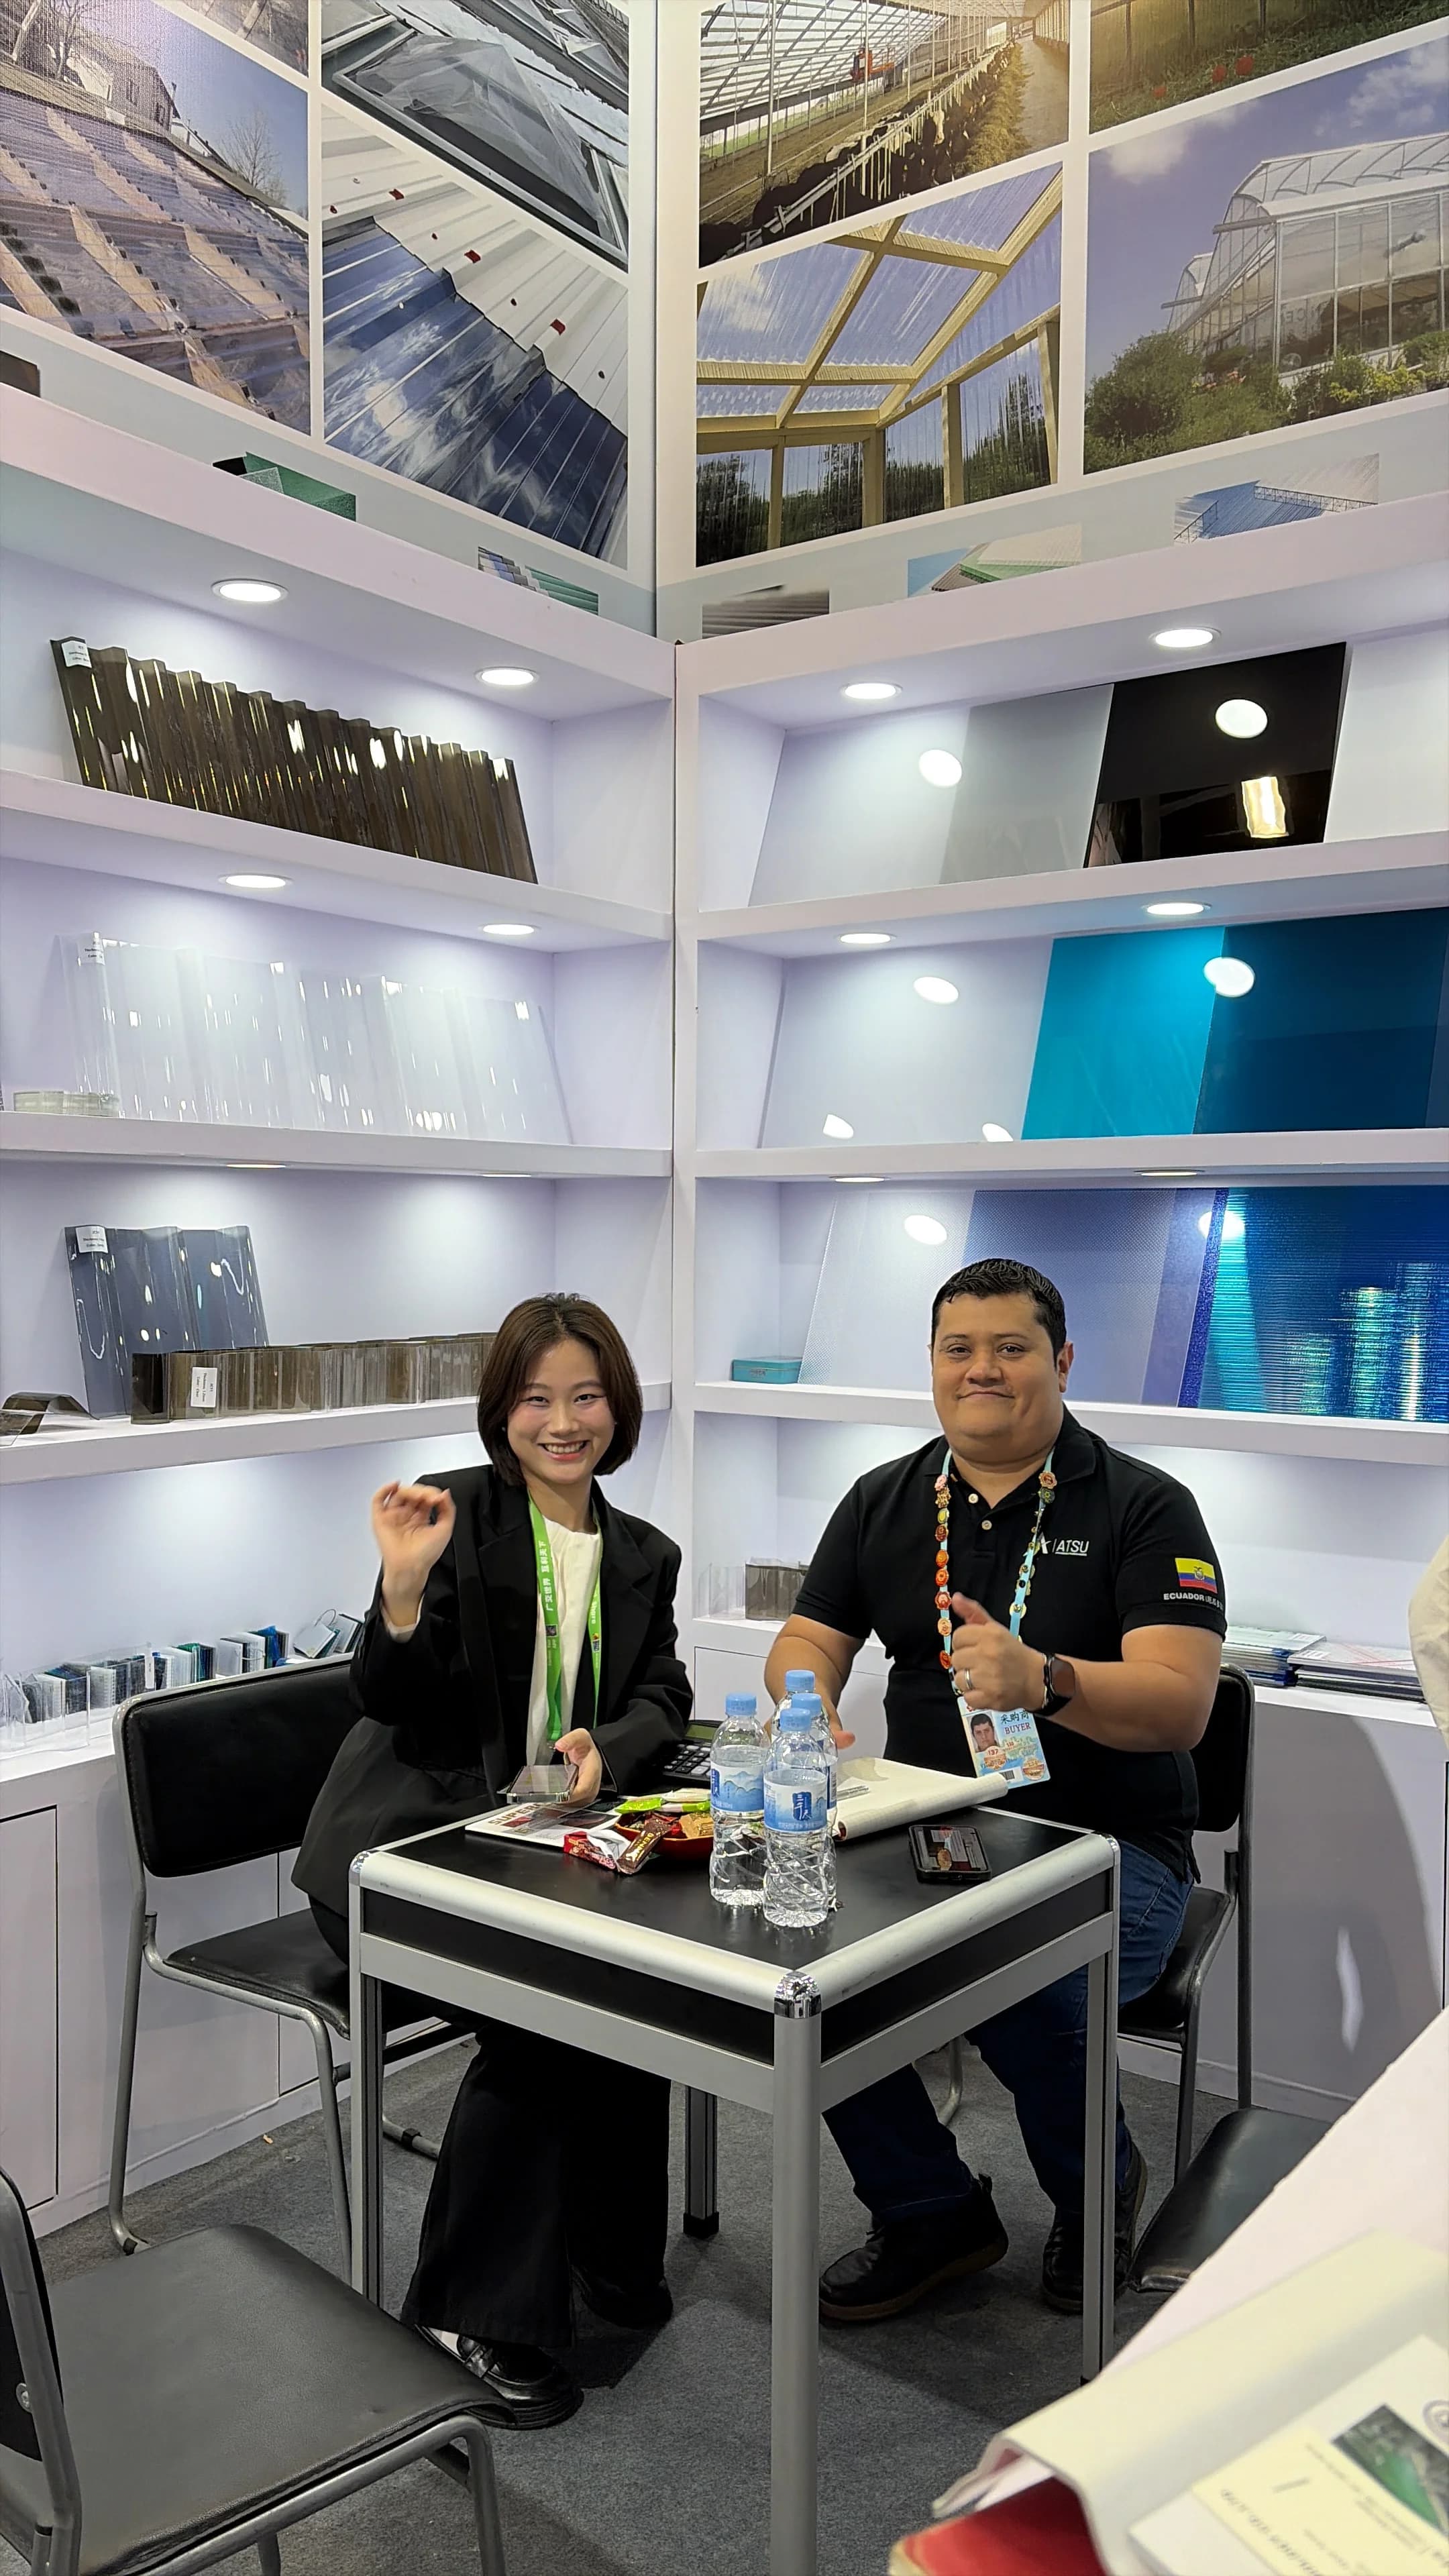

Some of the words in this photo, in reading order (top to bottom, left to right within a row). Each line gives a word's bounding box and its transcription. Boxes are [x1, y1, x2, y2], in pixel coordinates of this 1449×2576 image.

[1055, 1539, 1090, 1554] ATSU
[1163, 1592, 1205, 1601] ECUADOR
[1000, 1710, 1030, 1725] 采购商
[1004, 1722, 1031, 1735] BUYER
